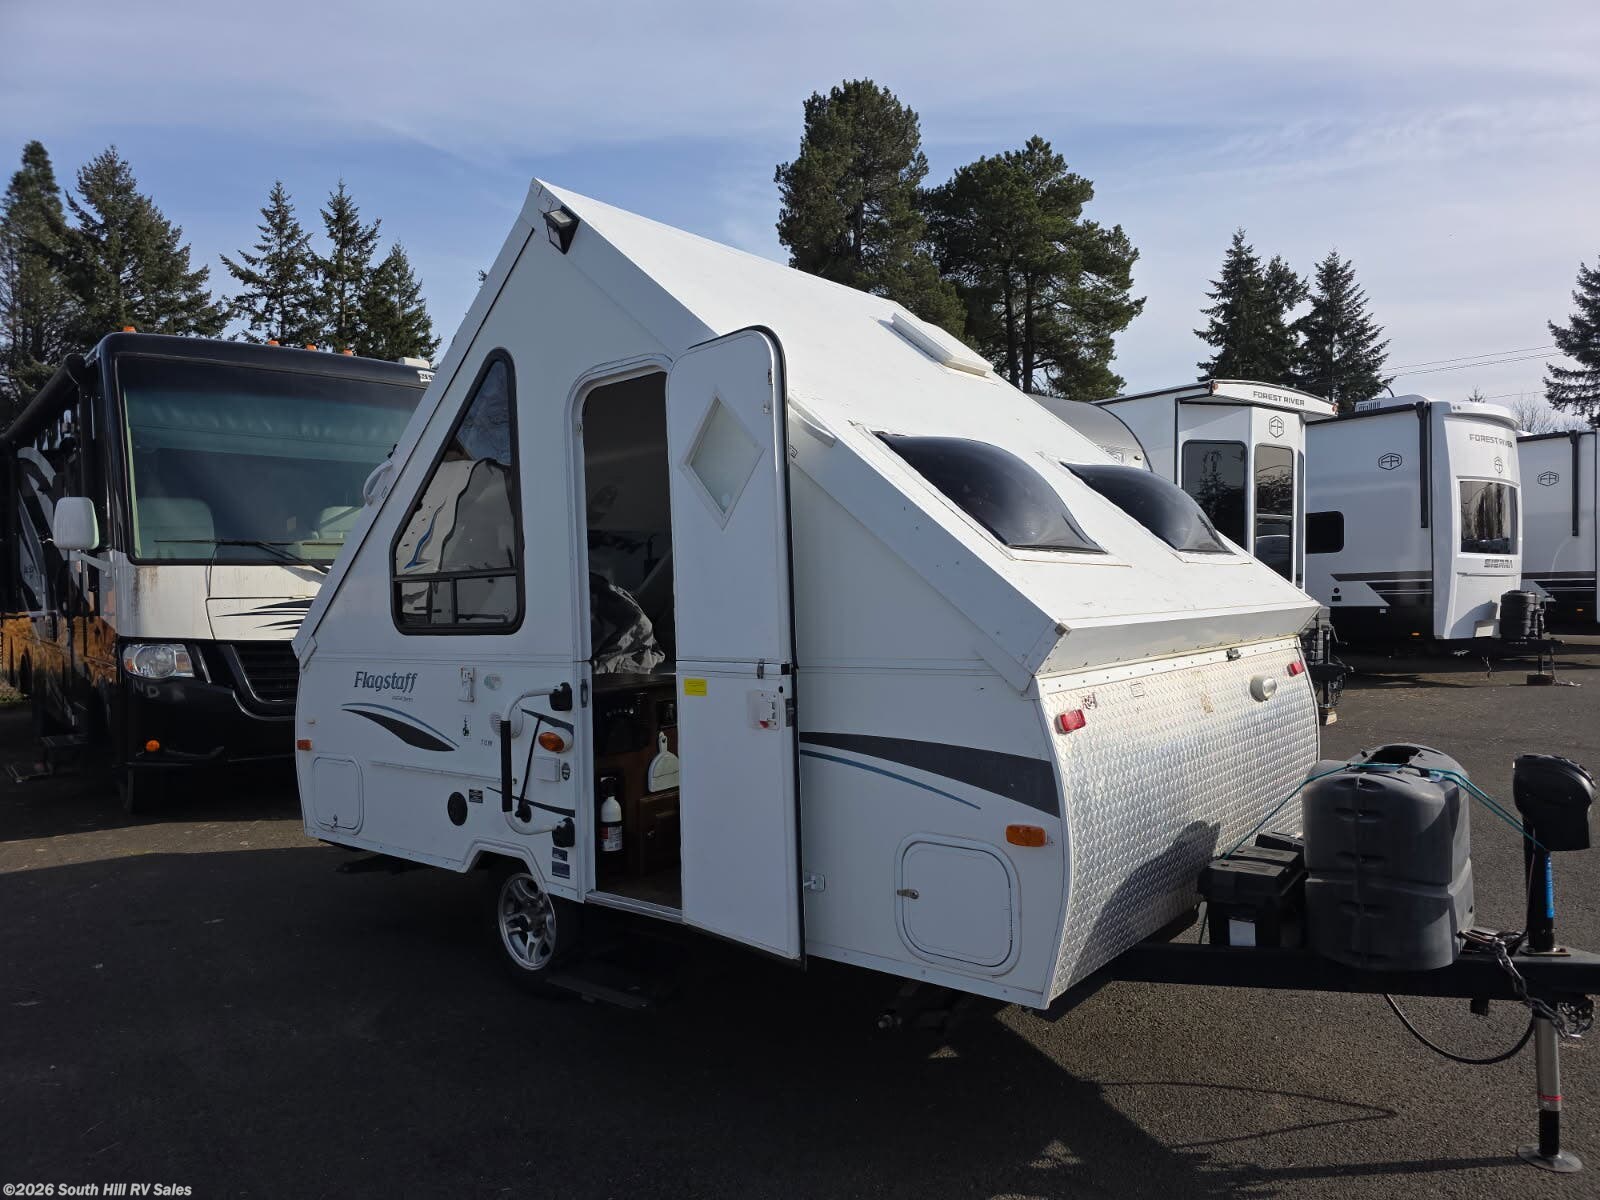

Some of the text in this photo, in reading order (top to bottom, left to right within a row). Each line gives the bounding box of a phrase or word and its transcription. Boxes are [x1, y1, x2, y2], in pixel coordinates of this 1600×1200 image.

[1253, 390, 1305, 406] FOREST RIVER
[1469, 433, 1498, 444] FOREST
[1484, 558, 1513, 569] SIERRA
[354, 671, 418, 693] Flagstaff
